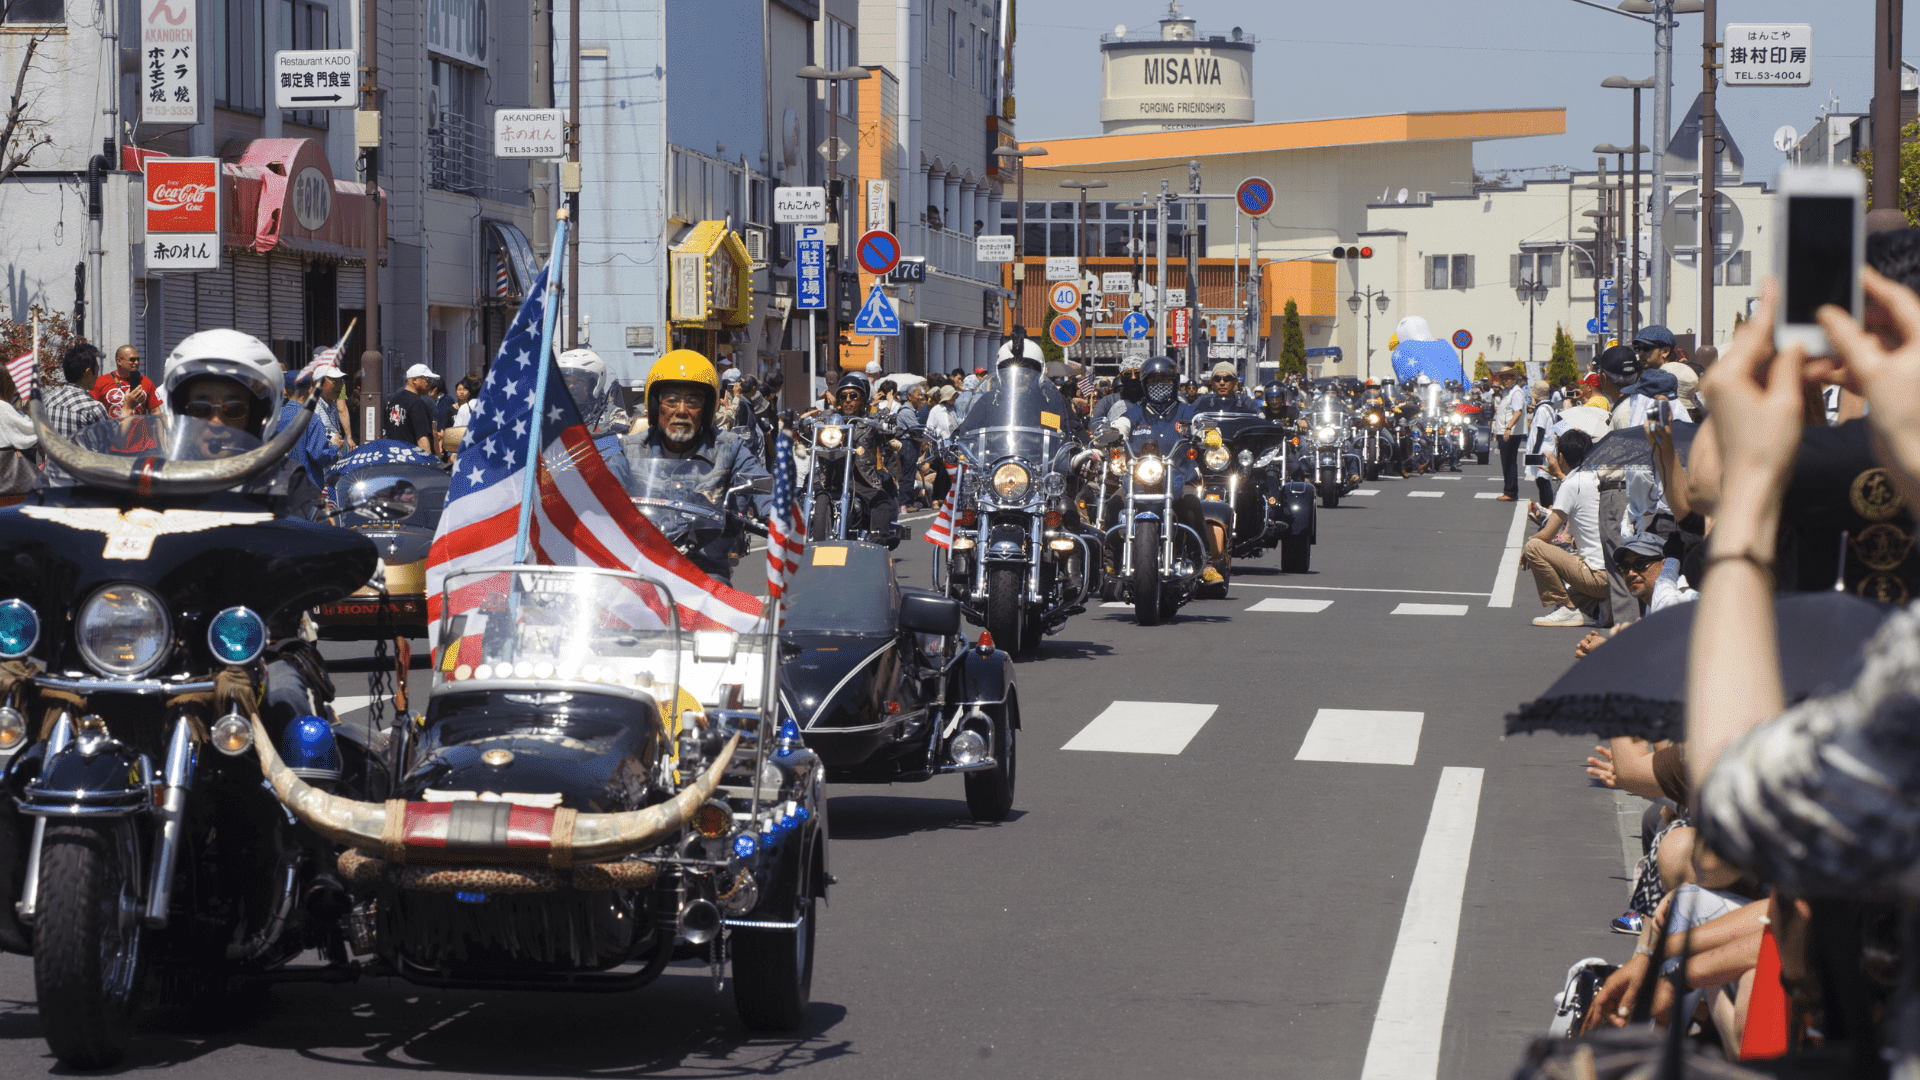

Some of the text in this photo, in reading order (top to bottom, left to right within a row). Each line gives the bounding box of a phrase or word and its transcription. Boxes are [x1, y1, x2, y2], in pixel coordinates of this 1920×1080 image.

[145, 29, 193, 42] AKANOREN
[1747, 31, 1791, 40] はんこや
[281, 56, 351, 66] Restaurant KADO
[1730, 46, 1807, 64] 掛村印房
[148, 47, 166, 102] ホルモン焼
[172, 46, 190, 102] バラ焼
[1145, 58, 1221, 85] MISAWA
[1735, 71, 1801, 80] TEL.53-4004
[1140, 103, 1226, 113] FORGING FRIENDSHIPS
[501, 125, 557, 141] 赤のれん
[153, 184, 207, 203] Coca-Cola
[778, 201, 820, 210] れんこんや
[803, 228, 817, 239] P
[154, 242, 211, 260] 赤のれん
[801, 250, 820, 295] 駐車場
[890, 263, 919, 278] 176
[1605, 280, 1614, 288] P
[1057, 290, 1073, 304] 40
